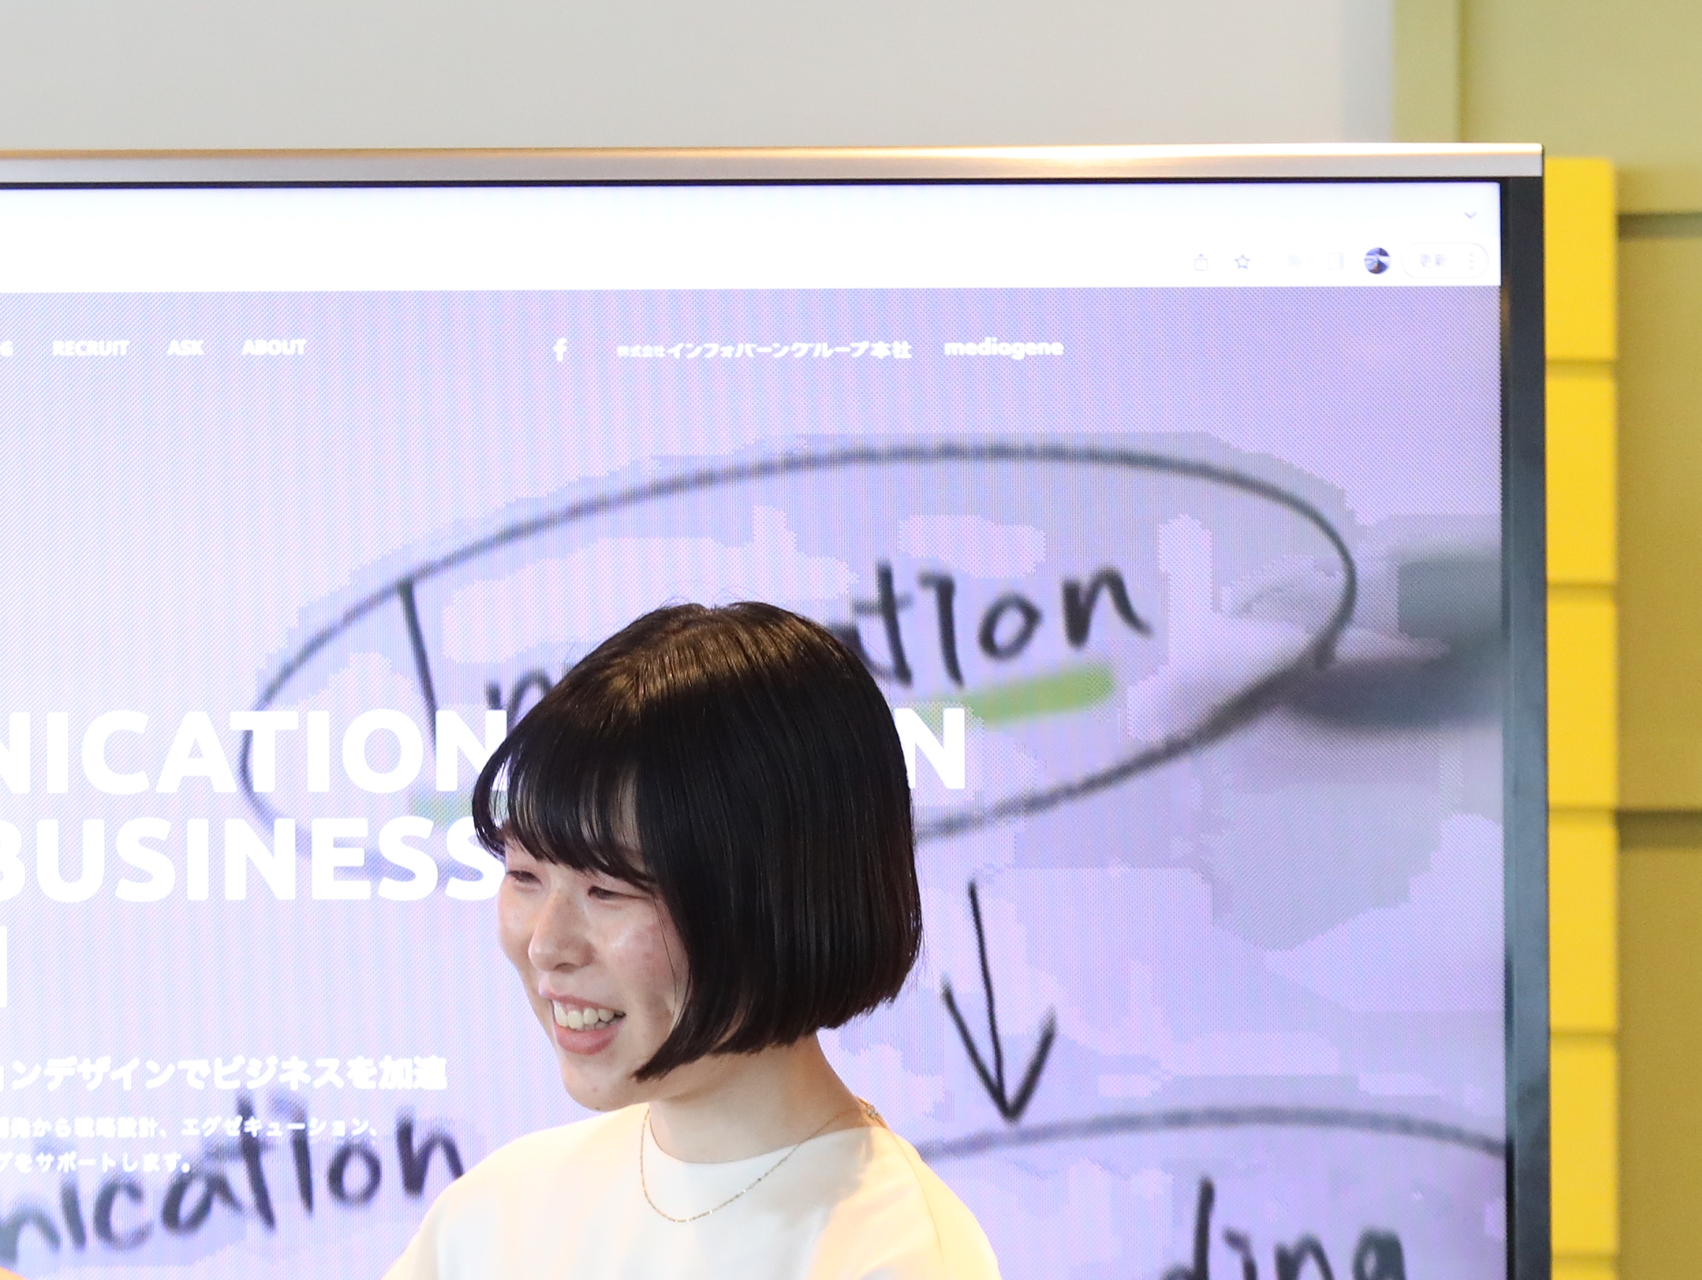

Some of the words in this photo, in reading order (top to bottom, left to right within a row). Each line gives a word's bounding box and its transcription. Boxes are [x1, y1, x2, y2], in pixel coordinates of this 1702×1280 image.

[52, 339, 130, 357] RECRUIT
[167, 339, 204, 357] ASK
[241, 338, 307, 356] ABOUT
